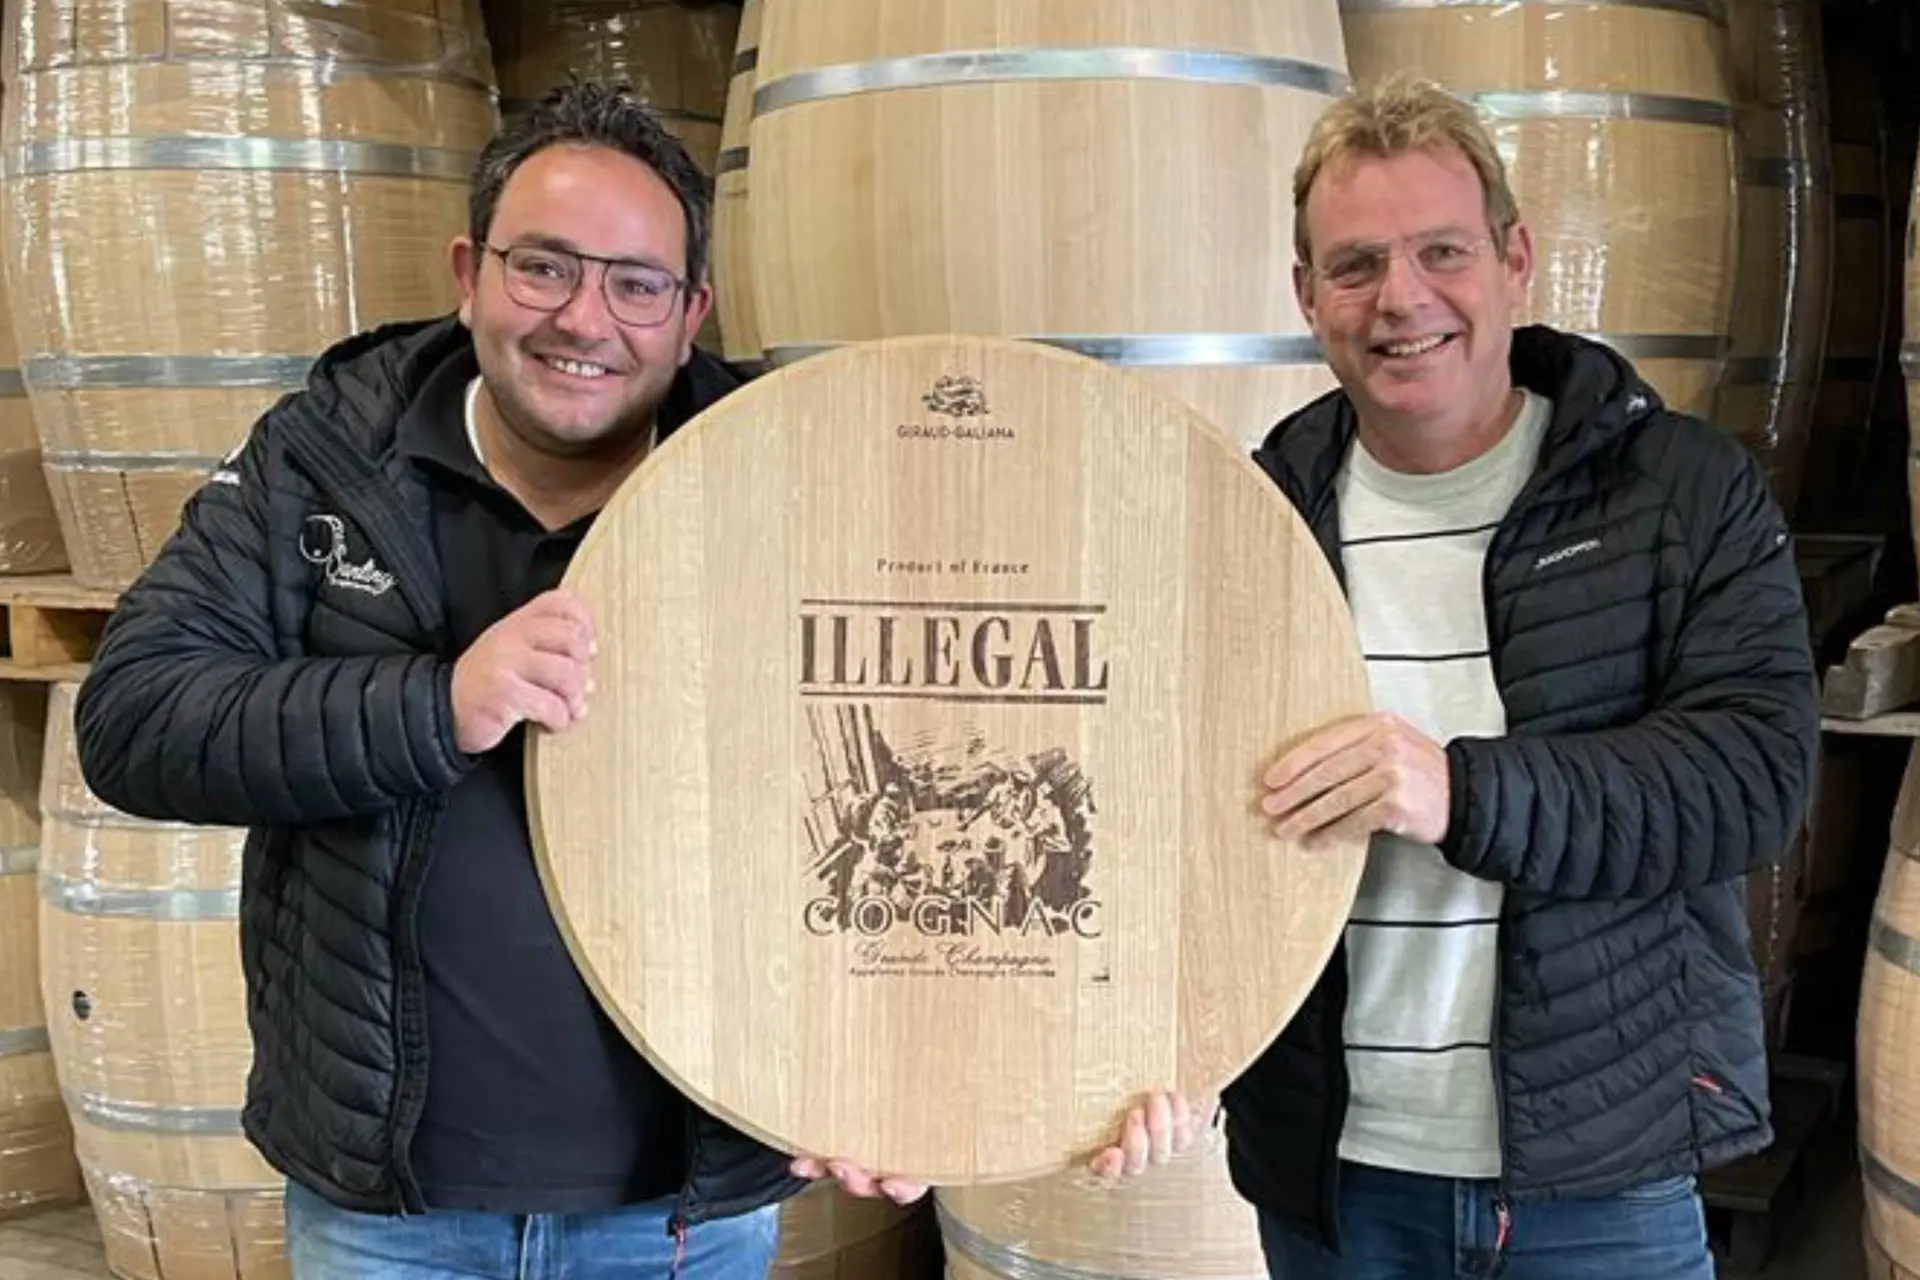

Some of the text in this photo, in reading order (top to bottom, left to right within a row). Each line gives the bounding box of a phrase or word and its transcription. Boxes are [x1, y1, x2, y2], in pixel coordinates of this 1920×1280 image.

[876, 557, 1030, 574] Product of France
[799, 613, 1108, 690] ILLEGAL
[803, 895, 1103, 938] COGNAC
[854, 941, 1052, 970] Grande Champagne
